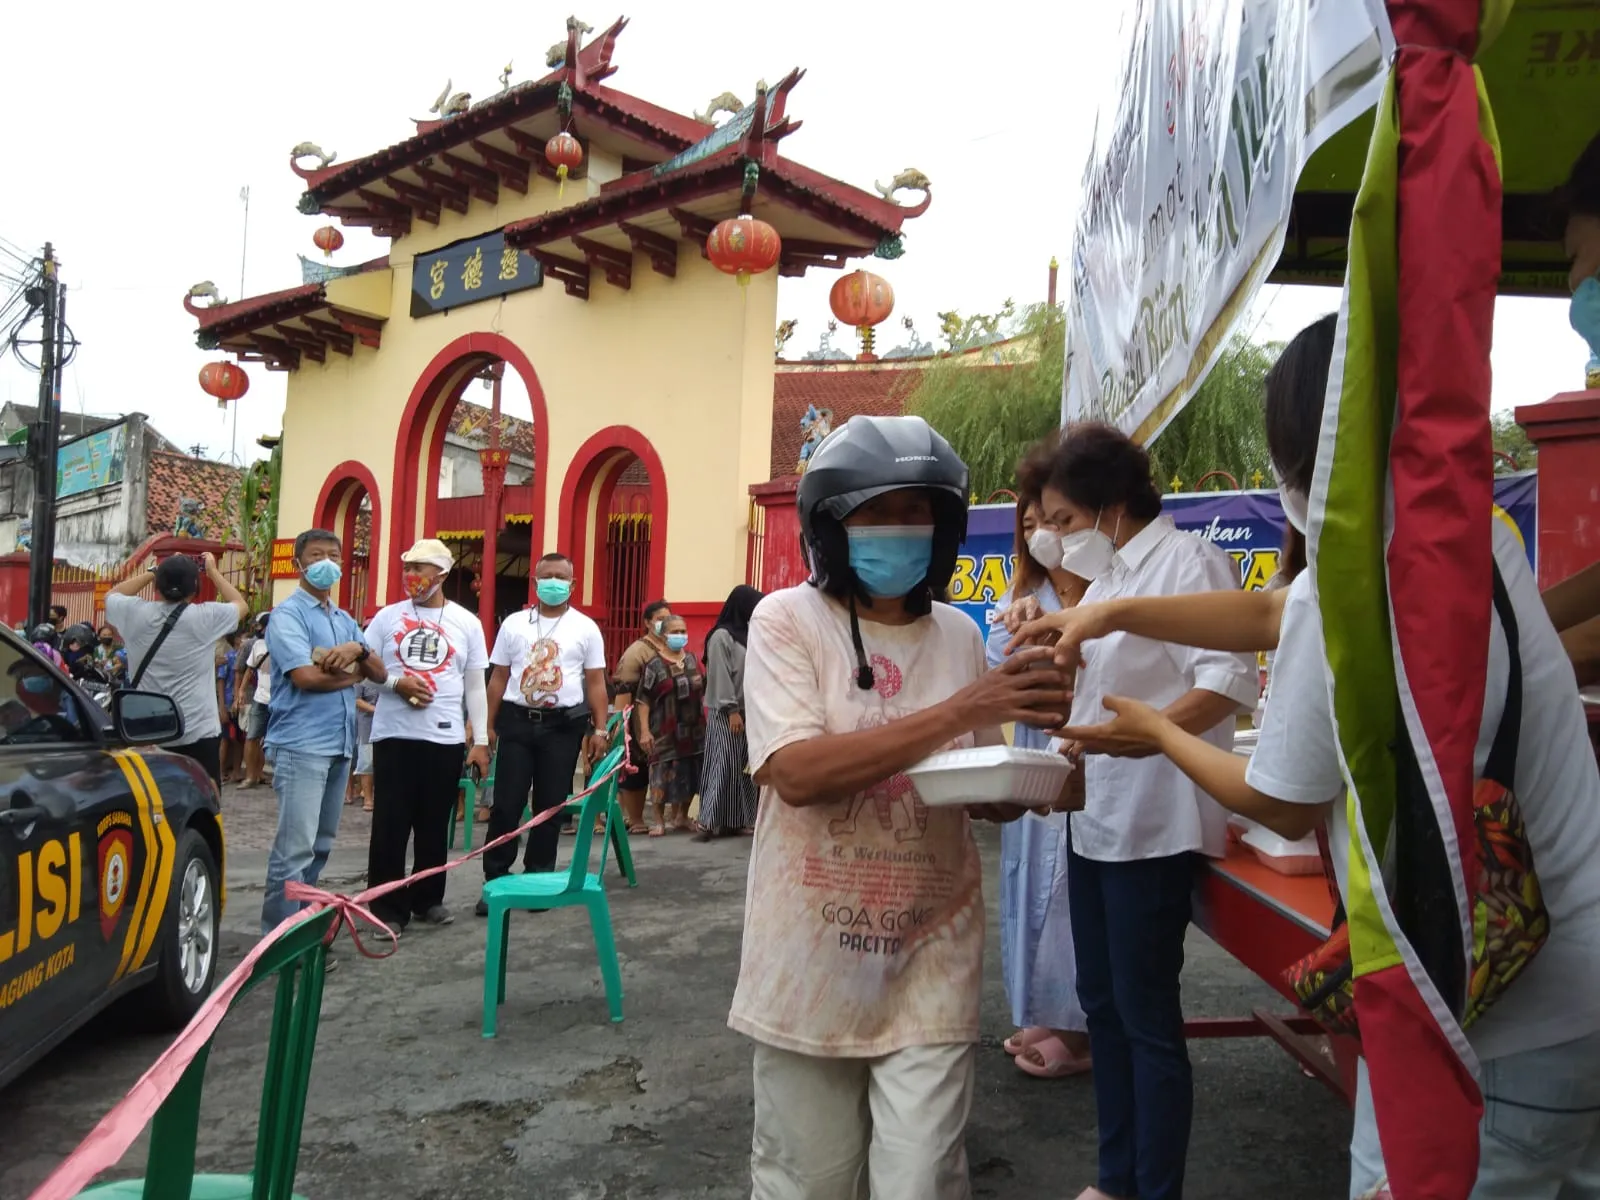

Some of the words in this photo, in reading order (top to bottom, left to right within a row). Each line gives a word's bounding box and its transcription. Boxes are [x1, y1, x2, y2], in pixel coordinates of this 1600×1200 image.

[895, 455, 939, 463] HONDA
[946, 554, 1018, 604] BA
[822, 902, 872, 930] GOA
[839, 932, 904, 955] PACITA
[45, 943, 75, 981] KOTA
